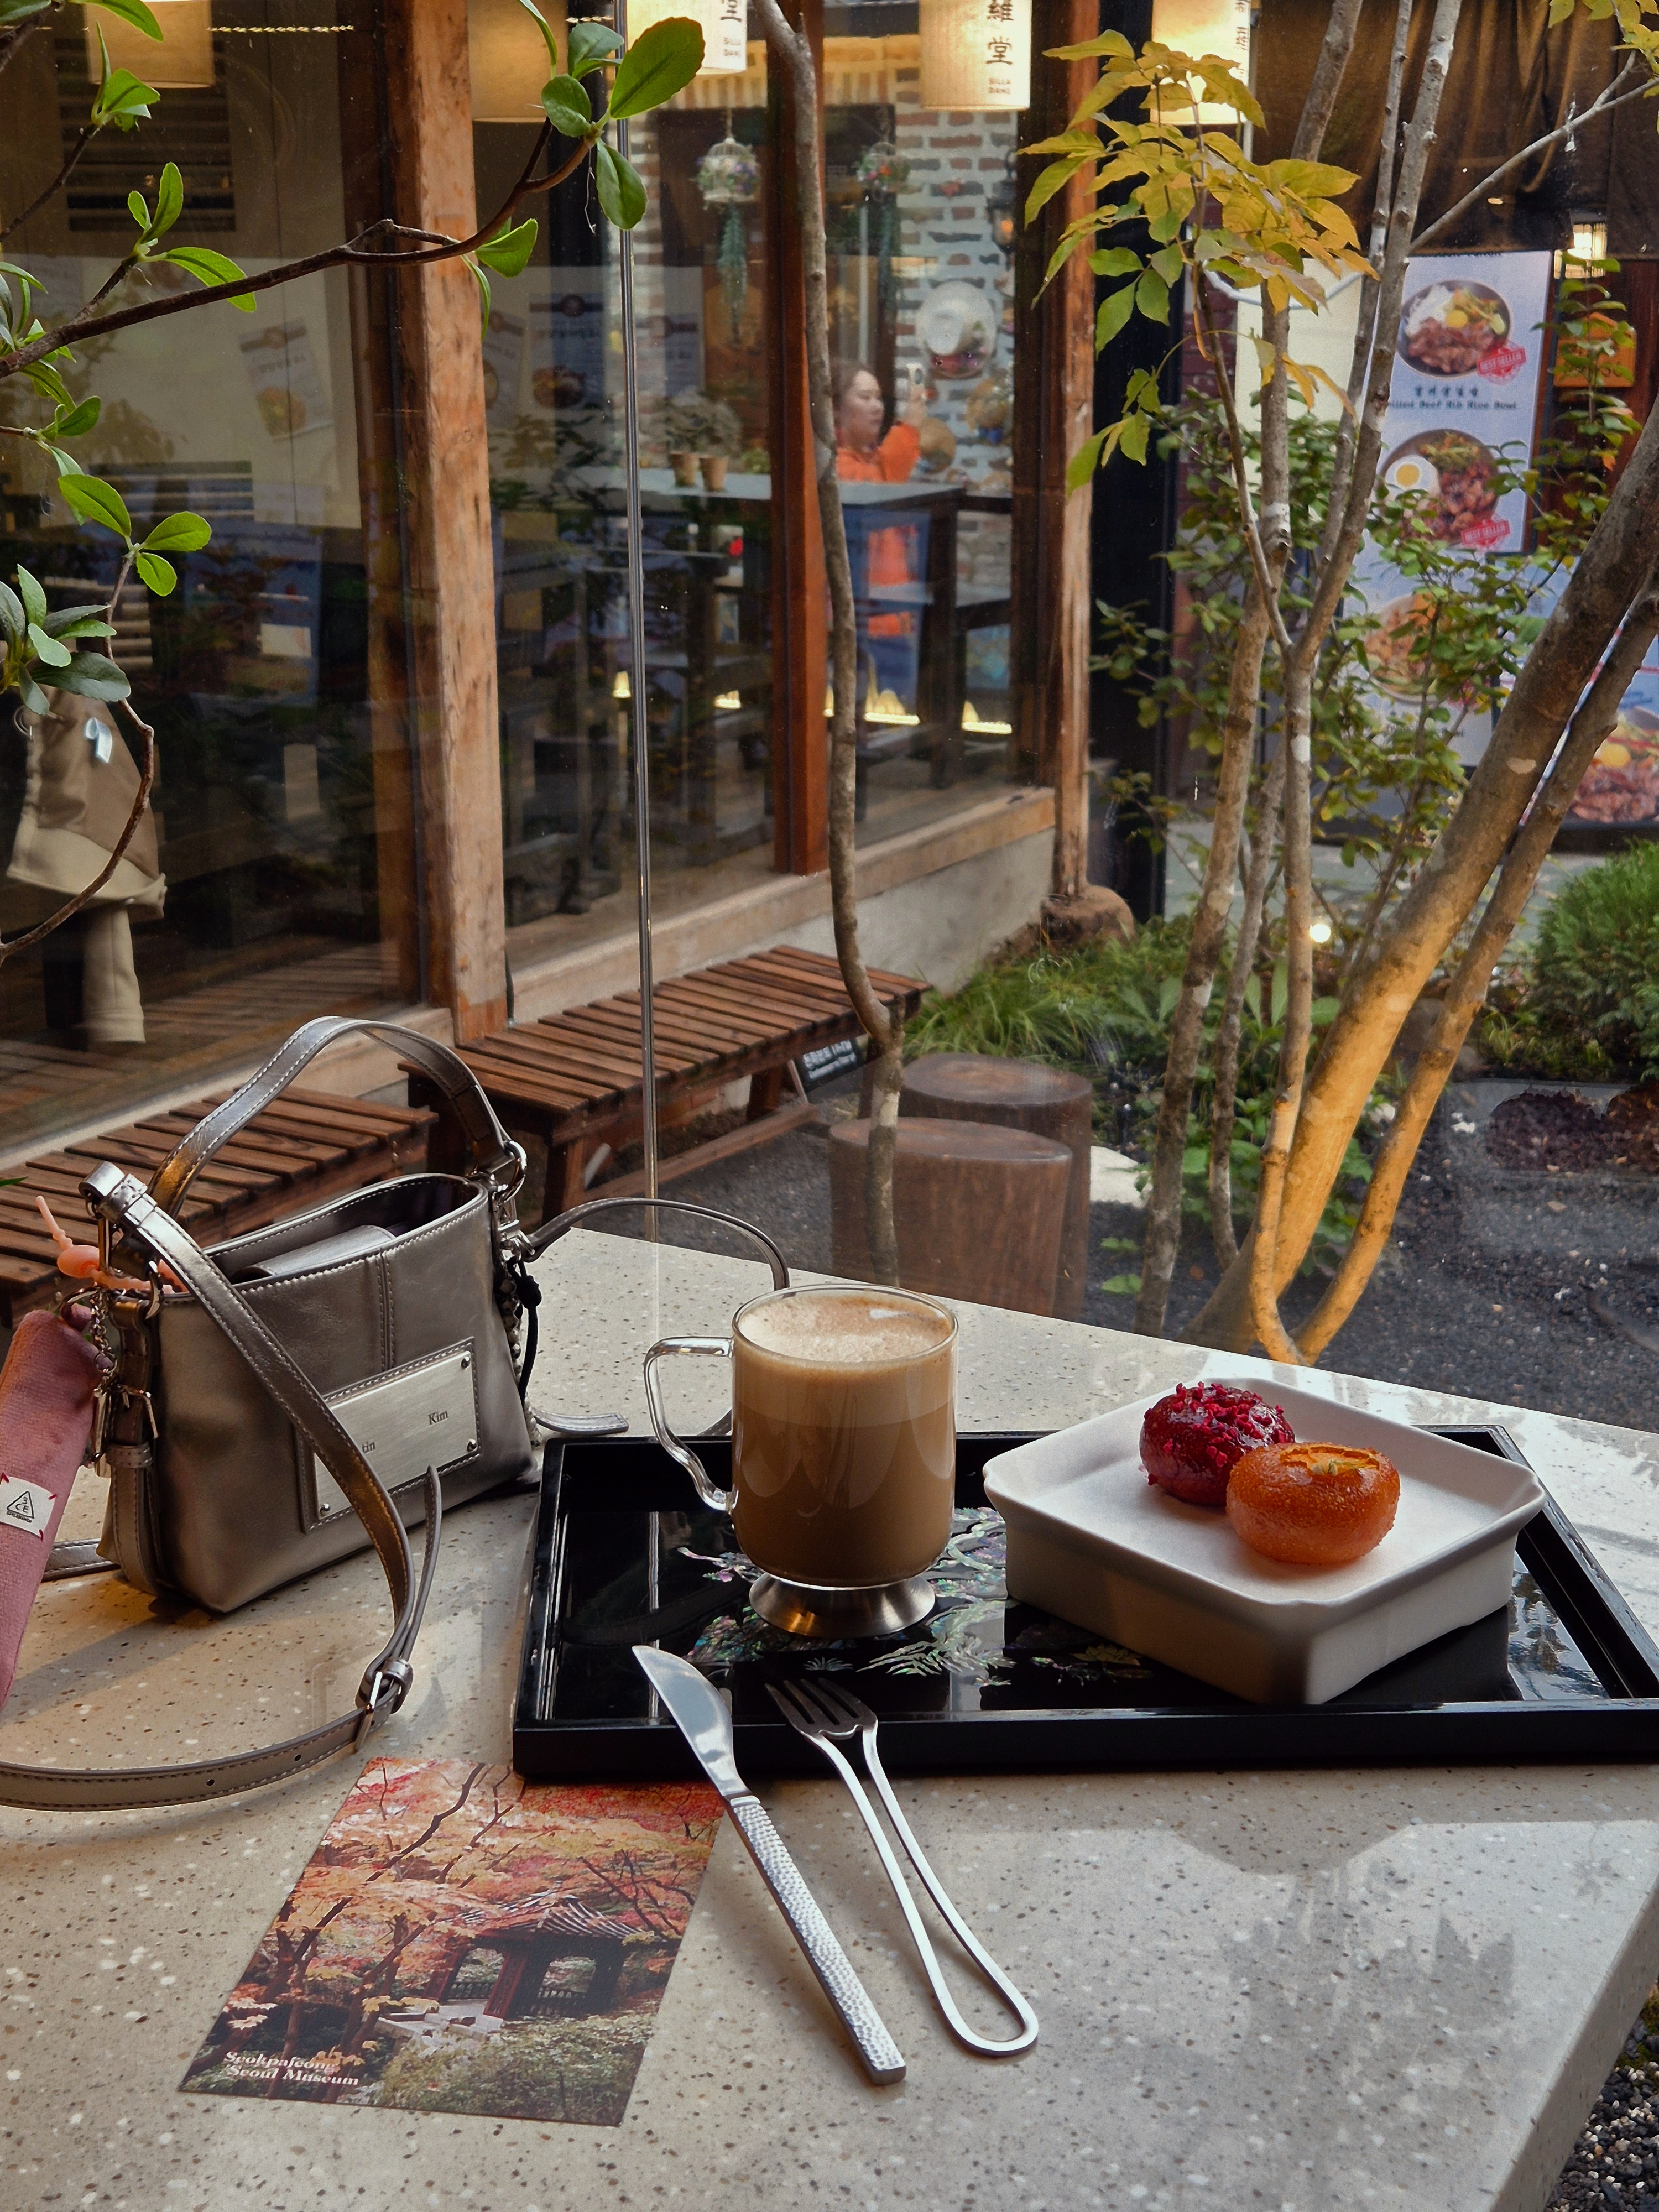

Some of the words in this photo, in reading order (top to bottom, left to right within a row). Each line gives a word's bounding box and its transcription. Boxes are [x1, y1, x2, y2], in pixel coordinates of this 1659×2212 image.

[1479, 358, 1496, 374] BEST
[1496, 349, 1522, 367] SELLER
[1389, 400, 1414, 408] illed
[1495, 401, 1516, 410] Bowl
[1464, 530, 1481, 543] BEST
[1482, 522, 1506, 538] SELLER
[427, 1410, 449, 1426] Kim
[15, 1503, 29, 1513] CE
[224, 2052, 338, 2074] Seokpajeong
[227, 2065, 279, 2079] Seoul
[283, 2069, 359, 2085] Museum
